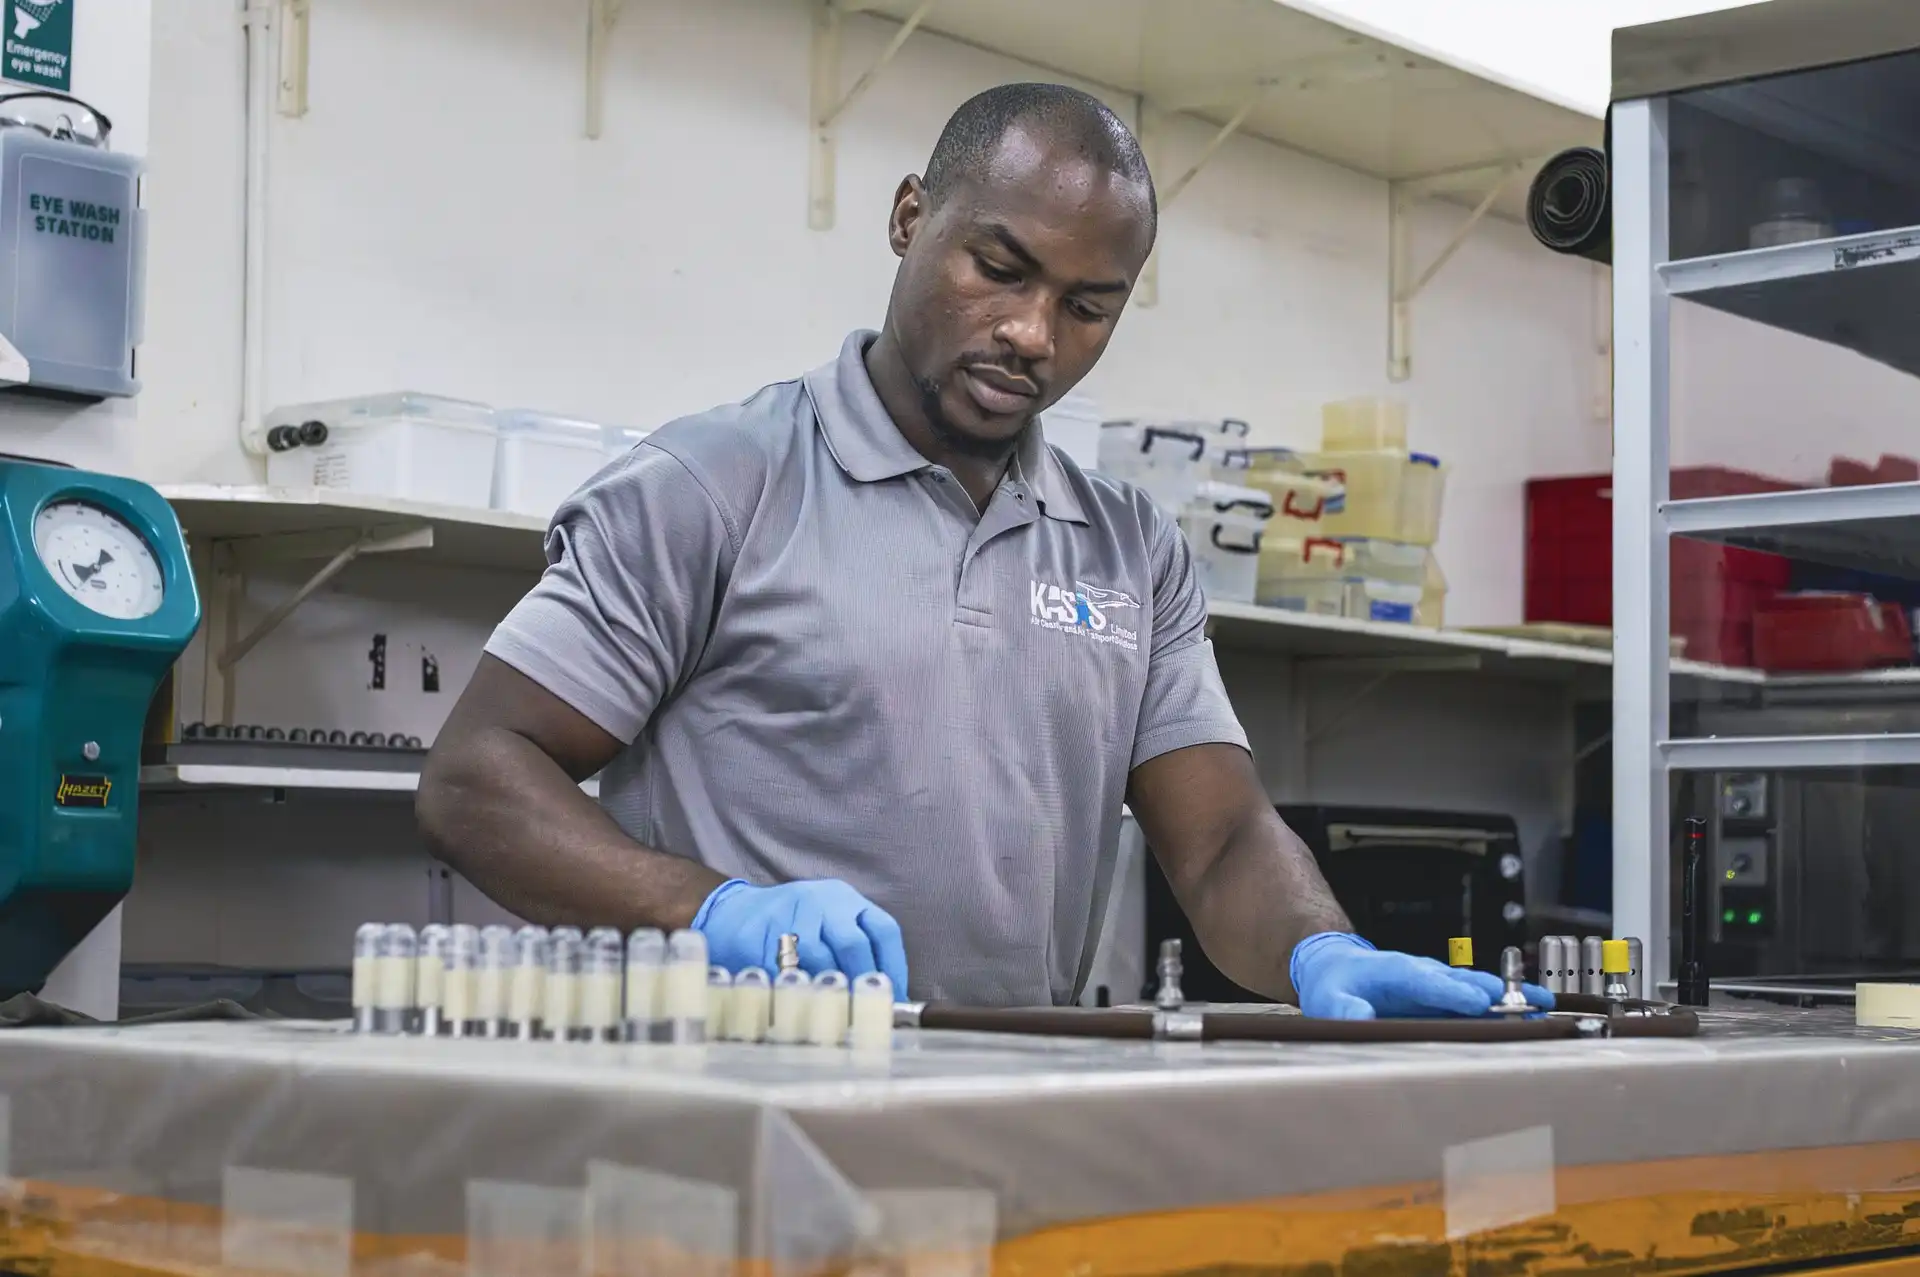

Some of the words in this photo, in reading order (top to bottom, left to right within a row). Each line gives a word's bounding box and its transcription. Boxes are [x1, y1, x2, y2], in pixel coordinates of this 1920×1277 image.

[6, 39, 67, 68] Emergency
[11, 57, 31, 73] eye
[34, 63, 62, 79] wash
[30, 193, 63, 214] EYE
[70, 200, 120, 225] WASH
[35, 215, 114, 244] STATION
[63, 783, 105, 797] HAZET
